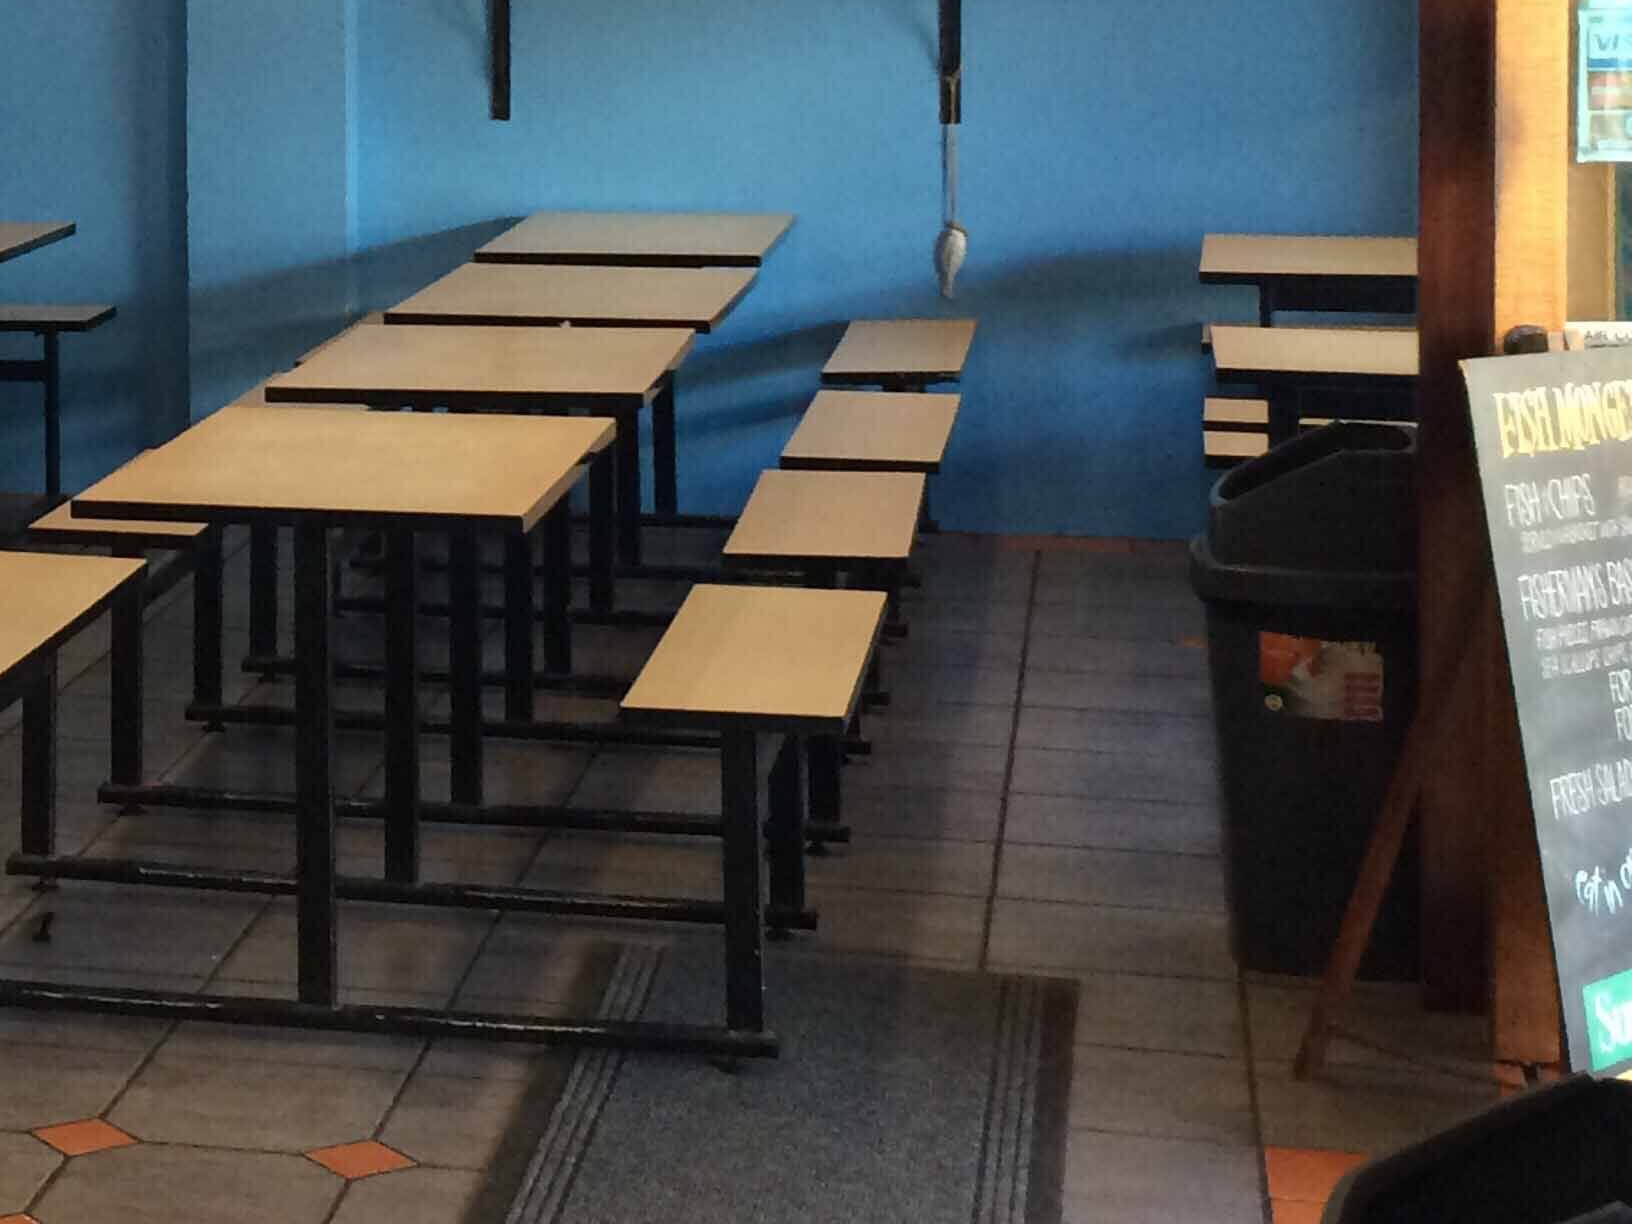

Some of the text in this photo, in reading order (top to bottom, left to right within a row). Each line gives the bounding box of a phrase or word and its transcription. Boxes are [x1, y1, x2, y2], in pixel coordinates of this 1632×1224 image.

[1492, 386, 1559, 458] FISH
[1503, 480, 1542, 528] FISH
[1547, 473, 1597, 521] CHIPS
[1550, 766, 1597, 821] FRESH
